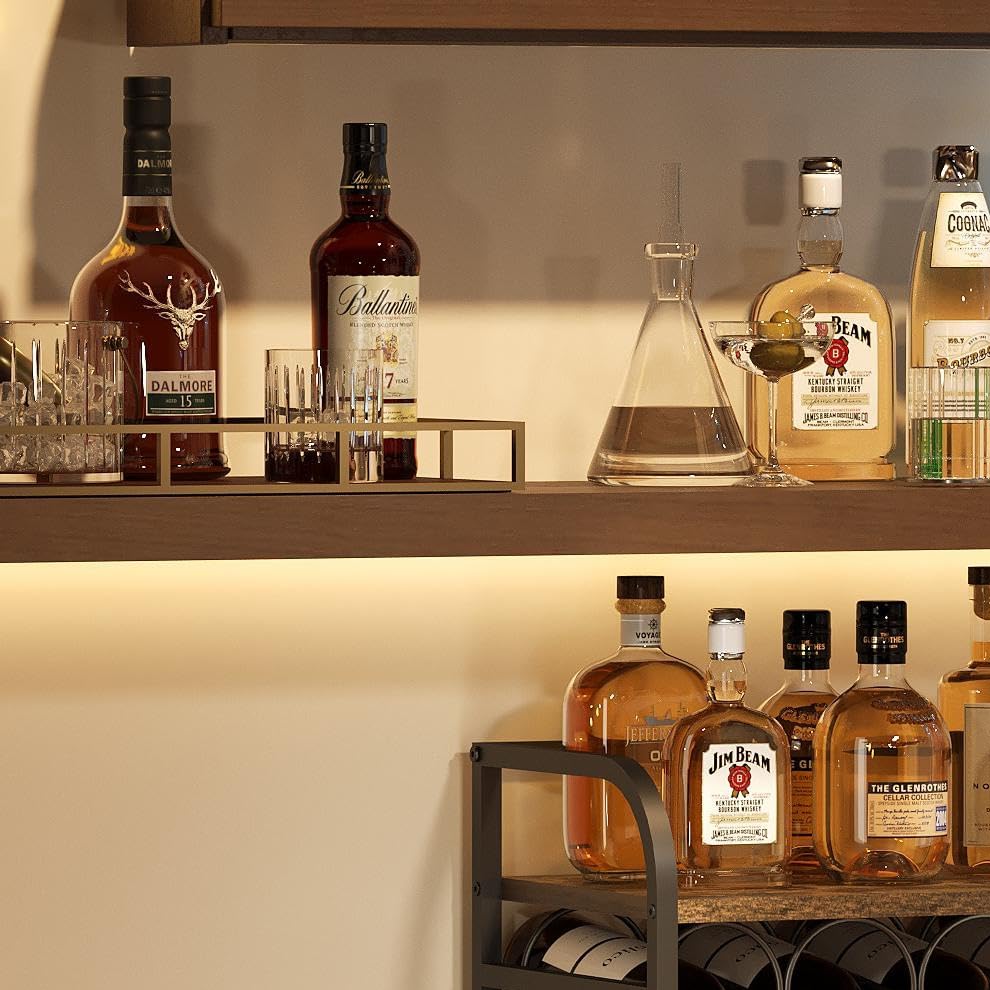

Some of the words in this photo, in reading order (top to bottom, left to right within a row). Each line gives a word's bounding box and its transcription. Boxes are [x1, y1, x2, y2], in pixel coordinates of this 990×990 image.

[947, 213, 990, 233] COGNAC
[831, 316, 871, 348] BEAM
[151, 380, 212, 392] DALMORE
[837, 377, 864, 385] STRAIGHT
[180, 394, 192, 407] 15
[708, 751, 733, 775] JIM
[736, 745, 771, 774] BEAM
[871, 784, 889, 792] THE
[892, 782, 947, 793] GLENROTHES
[911, 793, 944, 801] COLLECTION
